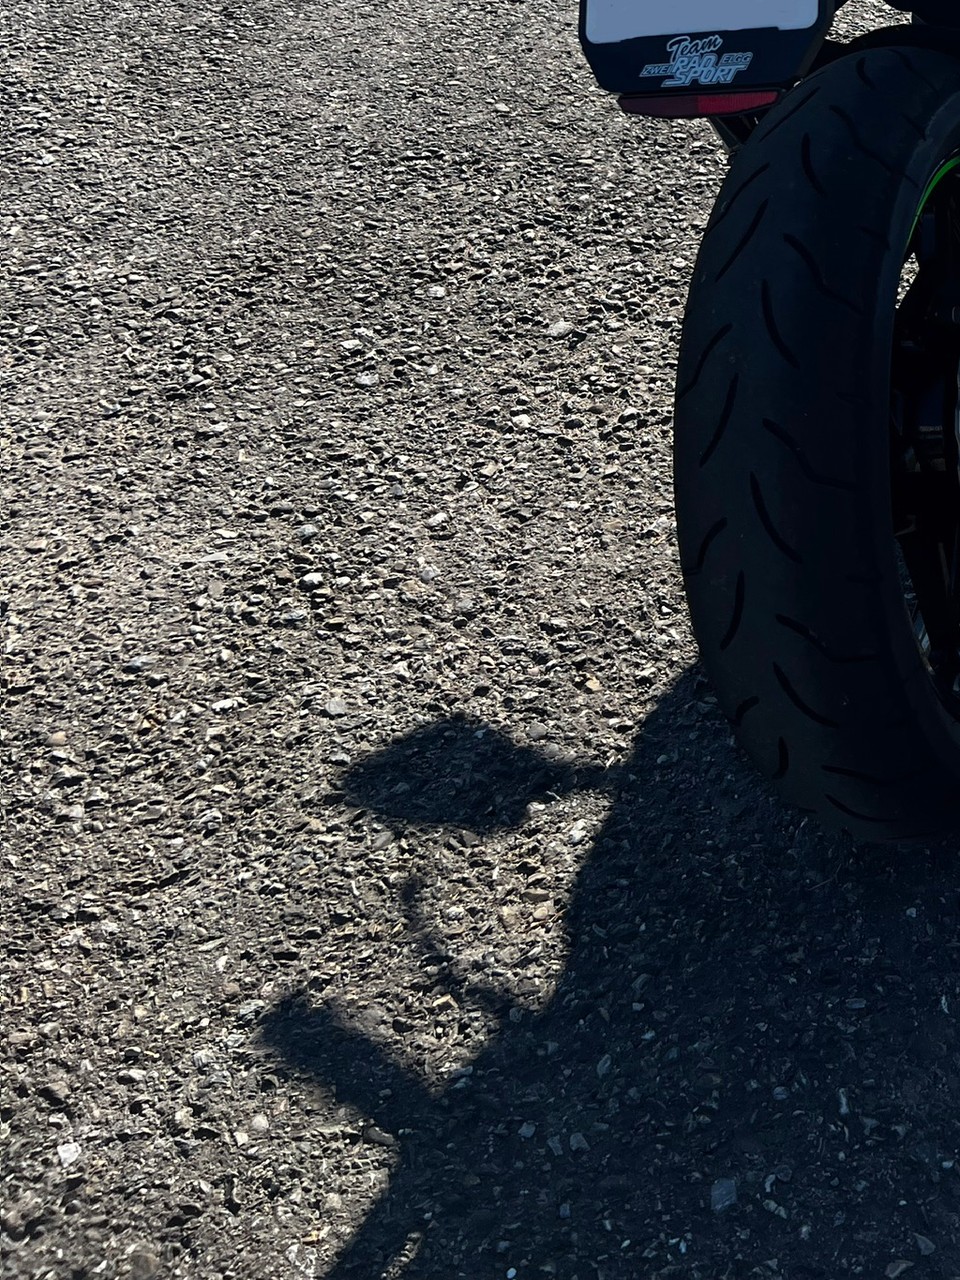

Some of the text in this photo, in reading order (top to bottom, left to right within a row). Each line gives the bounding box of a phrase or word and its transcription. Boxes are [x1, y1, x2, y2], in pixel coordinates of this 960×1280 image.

[666, 35, 723, 64] Team
[672, 53, 718, 73] RAD
[662, 65, 747, 87] SPORT
